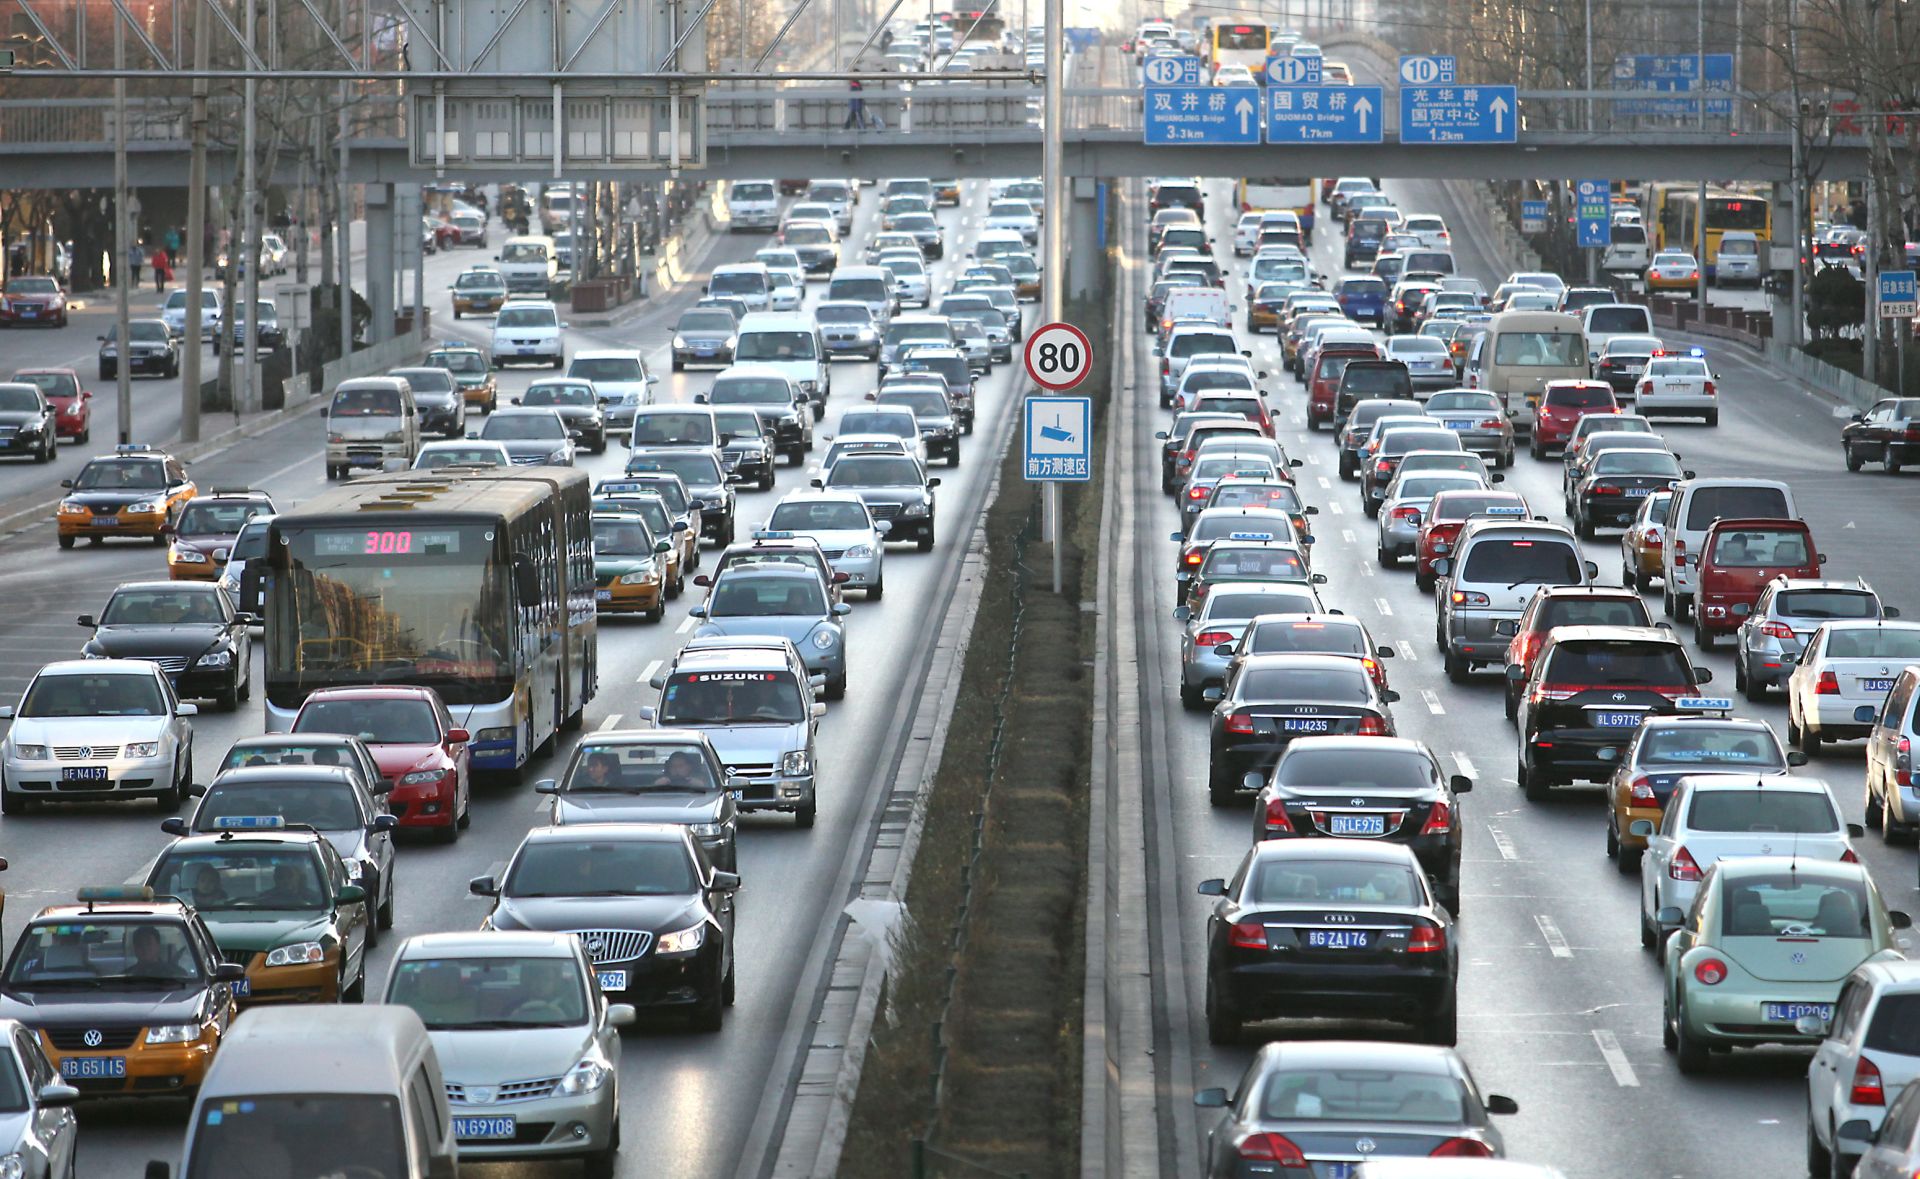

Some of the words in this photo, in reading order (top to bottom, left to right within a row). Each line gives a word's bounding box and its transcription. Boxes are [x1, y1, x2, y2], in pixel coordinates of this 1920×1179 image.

[1154, 61, 1175, 81] 13
[1184, 59, 1198, 83] 出口
[1277, 60, 1297, 80] 11
[1307, 58, 1319, 82] 出口
[1409, 60, 1431, 80] 10
[1440, 58, 1453, 82] 出口
[1154, 92, 1226, 111] 双井桥
[1274, 91, 1347, 110] 国贸桥
[1412, 89, 1479, 102] 光华路
[1202, 115, 1226, 124] Bridge
[1275, 113, 1313, 121] GUOMAO
[1317, 113, 1345, 123] Bridge
[1411, 108, 1480, 122] 国贸中心
[1166, 125, 1204, 139] 3.3km
[1299, 125, 1333, 139] 1.7km
[1428, 128, 1464, 141] 1.2km
[1039, 342, 1080, 373] 80
[1028, 457, 1087, 476] 前方测速区
[365, 531, 412, 554] 300
[700, 673, 765, 682] SUZUKI
[1299, 720, 1328, 731] J4235
[1328, 932, 1367, 946] ZA176
[82, 1060, 124, 1075] G5115
[469, 1119, 514, 1136] G9Y08
